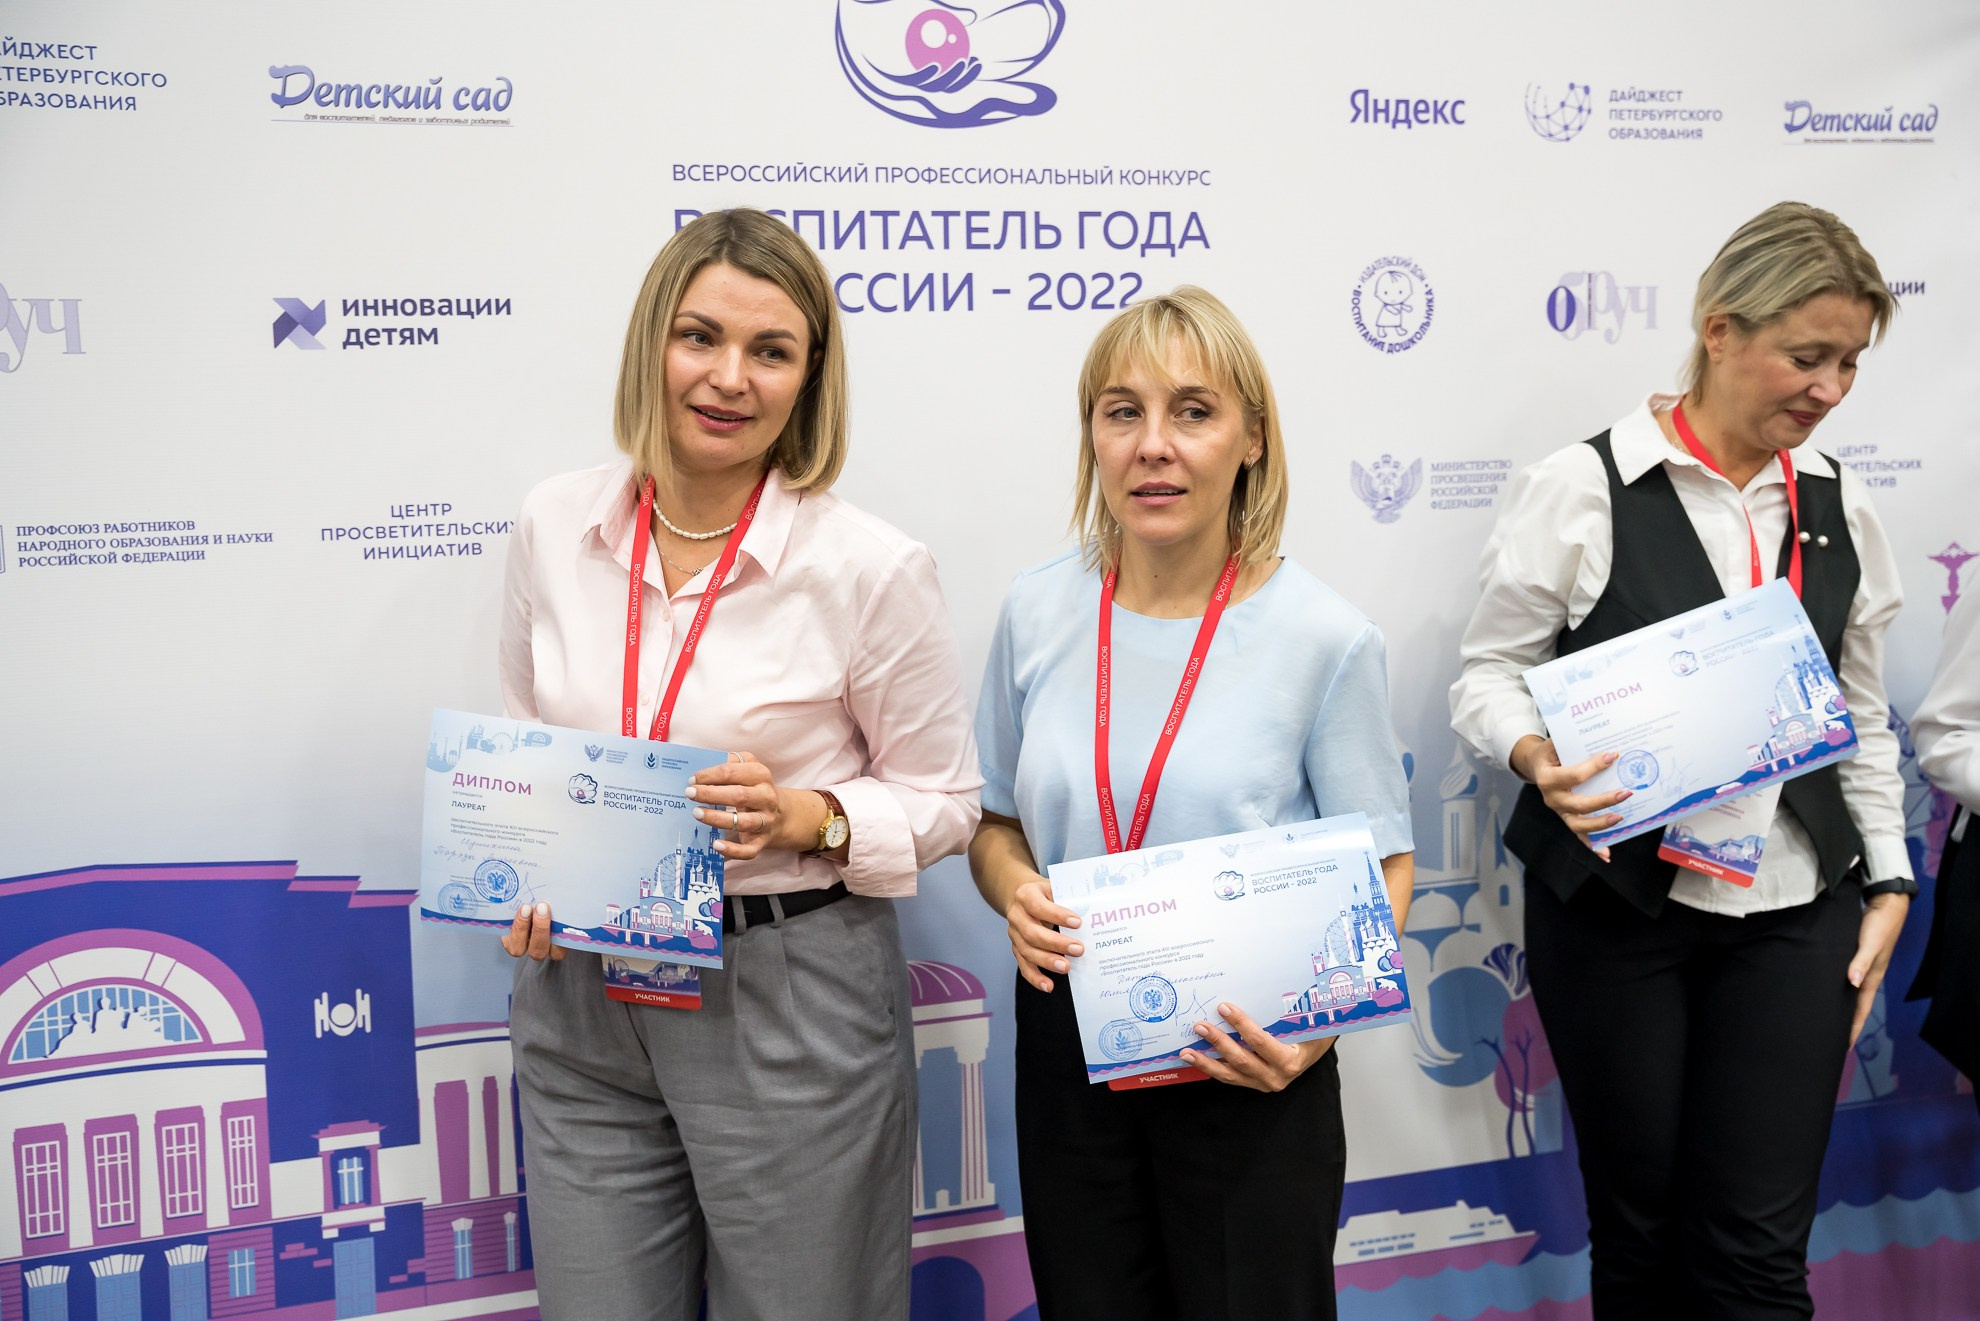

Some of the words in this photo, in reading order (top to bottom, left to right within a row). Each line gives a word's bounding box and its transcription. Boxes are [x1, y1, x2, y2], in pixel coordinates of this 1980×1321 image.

[0, 36, 97, 60] ЙДЖЕСТ
[0, 66, 167, 88] ТЕРБУРГСКОГО
[268, 65, 442, 110] Детский
[453, 77, 513, 112] сад
[1609, 86, 1683, 103] ДАЙДЖЕСТ
[1350, 89, 1465, 129] Яндекс
[1609, 109, 1723, 122] ПЕТЕРБУРГСКОГО
[1784, 100, 1893, 134] Детский
[1899, 104, 1938, 132] сад
[1608, 128, 1703, 140] ОБРАЗОВАНИЯ
[672, 162, 868, 183] ВСЕРОССИЙСКИЙ
[875, 166, 1113, 185] ПРОФЕССИОНАЛЬНЫЙ
[1119, 169, 1212, 186] КОНКУРС
[674, 209, 1062, 250] ПИТАТЕЛЬ
[1078, 210, 1211, 258] ГОДА
[1027, 271, 1143, 311] 2022
[342, 298, 512, 319] инновации
[1351, 289, 1386, 352] ВОСПИТАНИЕ
[1387, 288, 1434, 354] ДОШКОЛЬНИКА
[342, 327, 439, 350] детям
[1431, 460, 1512, 472] МИНИСТЕРСТВО
[1431, 472, 1507, 484] ПРОСВЕЩЕНИЯ
[1431, 484, 1498, 497] РОССИЙСКОЙ
[390, 503, 452, 519] ЦЕНТР
[1431, 498, 1492, 510] ФЕДЕРАЦИИ
[16, 523, 100, 537] ПРОФСОЮЗ
[104, 520, 196, 533] РАБОТНИКОВ
[17, 538, 106, 552] НАРОДНОГО
[110, 535, 209, 549] ОБРАЗОВАНИЯ
[213, 534, 223, 545] И
[226, 532, 273, 544] НАУКИ
[363, 542, 482, 560] ИНИЦИАТИВ
[18, 551, 118, 567] РОССИЙСКОЙ
[121, 550, 205, 564] ФЕДЕРАЦИИ
[630, 563, 641, 622] ВОСПИТАТЕЛЬ
[685, 596, 712, 653] ВОСПИТАТЕЛЬ
[709, 573, 722, 595] ГОДА
[629, 624, 637, 647] ГОДА
[1100, 645, 1108, 704] ВОСПИТАТЕЛЬ
[1164, 678, 1192, 735] ВОСПИТАТЕЛЬ
[1188, 657, 1200, 678] ГОДА
[1571, 682, 1643, 718] ДИПЛОМ
[657, 711, 668, 733] ГОДА
[1099, 705, 1107, 728] ГОДА
[1579, 719, 1610, 735] ЛАУРЕАТ
[452, 772, 532, 795] ДИПЛОМ
[451, 800, 486, 812] ЛАУРЕАТ
[603, 791, 663, 806] ВОСПИТАТЕЛЬ
[663, 800, 687, 810] ГОДА
[603, 800, 637, 811] РОССИИ
[644, 806, 664, 815] 2022
[1139, 793, 1151, 815] ГОДА
[1101, 787, 1118, 847] ВОСПИТАТЕЛЬ
[1252, 869, 1314, 886] ВОСПИТАТЕЛЬ
[1314, 864, 1339, 875] ГОДА
[1688, 858, 1724, 876] УЧАСТНИК
[1253, 882, 1289, 894] РОССИИ
[1297, 876, 1317, 887] 2022
[1091, 898, 1177, 929] ДИПЛОМ
[1095, 935, 1134, 949] ЛАУРЕАТ
[1178, 954, 1191, 962] 2022
[635, 993, 670, 1003] УЧАСТНИК
[1139, 1073, 1179, 1083] УЧАСТНИК
